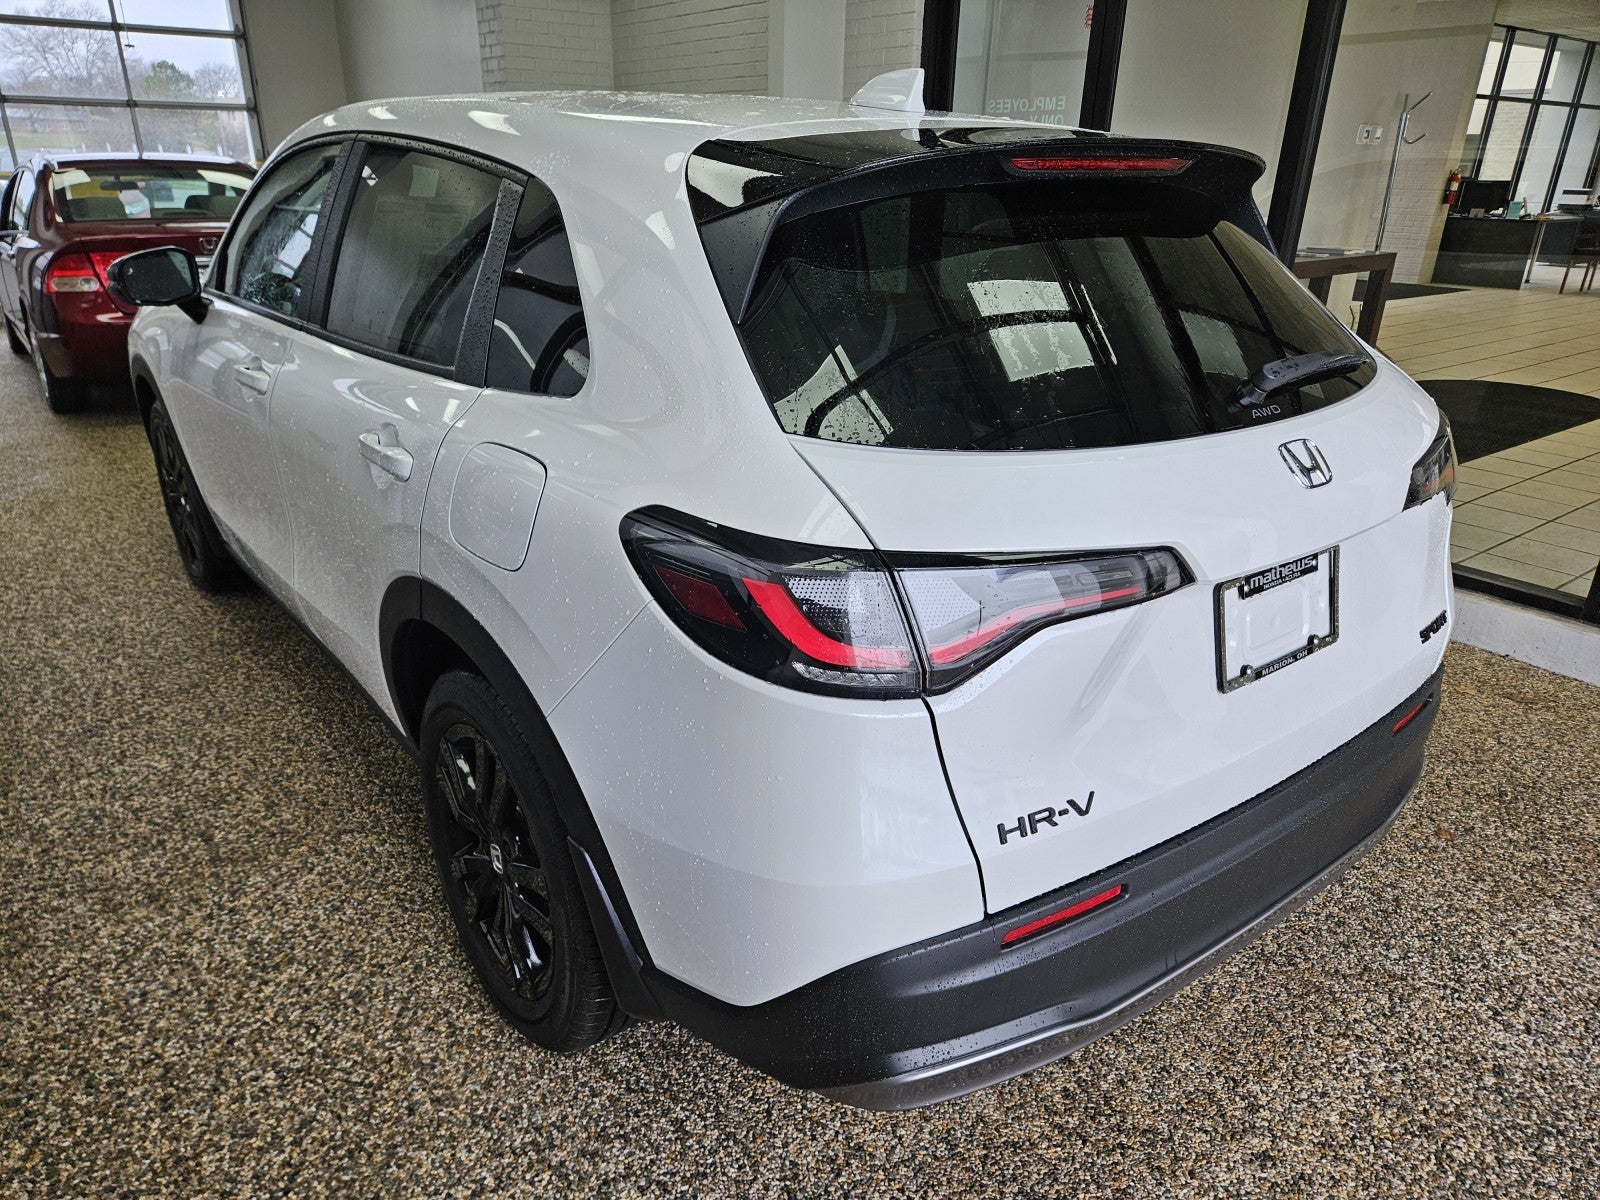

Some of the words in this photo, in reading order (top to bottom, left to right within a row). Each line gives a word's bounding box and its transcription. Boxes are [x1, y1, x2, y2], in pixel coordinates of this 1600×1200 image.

[1252, 404, 1281, 418] AWD
[1250, 556, 1313, 589] mathews
[1296, 649, 1308, 660] OH
[996, 790, 1095, 846] HR-V
